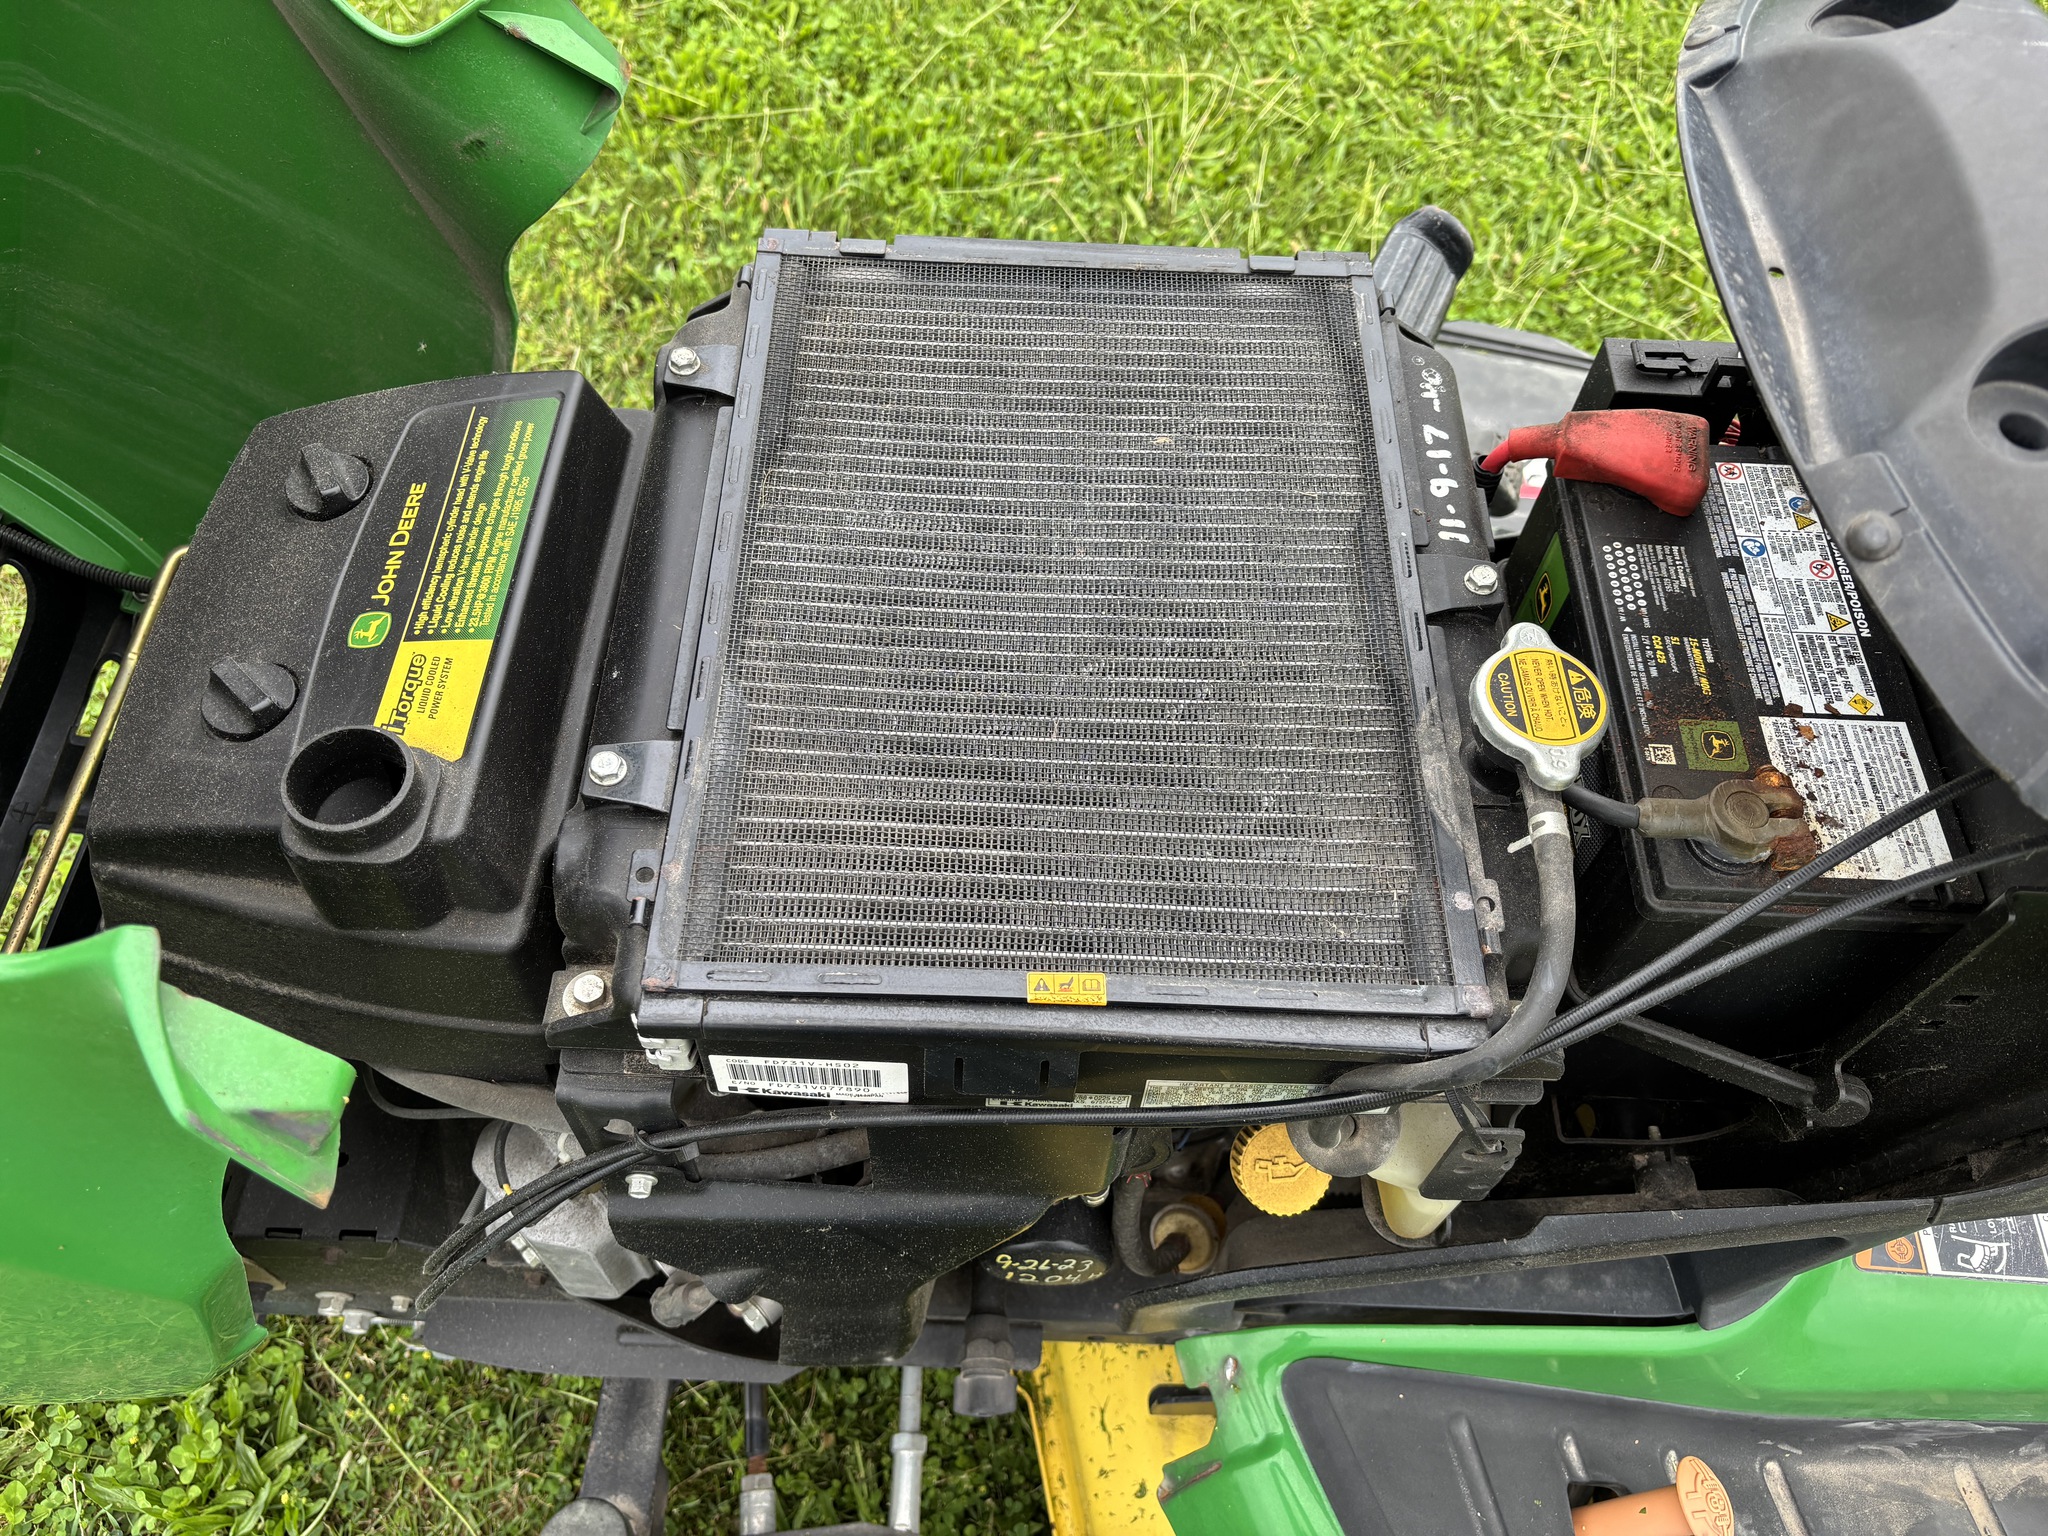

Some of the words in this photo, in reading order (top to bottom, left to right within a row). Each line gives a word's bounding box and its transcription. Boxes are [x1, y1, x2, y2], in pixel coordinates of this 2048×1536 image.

[468, 415, 489, 449] technology
[505, 419, 523, 452] conditions
[521, 421, 535, 441] power
[461, 449, 479, 473] V-Valve
[477, 449, 490, 459] life
[499, 452, 514, 471] tough
[515, 442, 530, 460] gross
[457, 473, 471, 487] with
[471, 460, 487, 482] engine
[508, 460, 525, 486] certified
[492, 471, 509, 496] through
[515, 476, 530, 496] 675cc
[451, 488, 467, 504] head
[463, 483, 481, 509] extends
[443, 505, 462, 531] cylinder
[459, 510, 473, 523] and
[471, 502, 487, 525] design
[484, 497, 501, 524] charges
[496, 487, 517, 530] manufacturer
[453, 524, 468, 543] noise
[462, 526, 481, 553] cylinder
[504, 521, 517, 536] SAE
[371, 549, 404, 606] JOHN
[389, 481, 427, 546] DEERE
[431, 532, 454, 573] hemispheric
[474, 525, 493, 559] response
[489, 531, 505, 554] engine
[500, 538, 513, 551] with
[444, 544, 463, 571] reduces
[456, 554, 472, 575] V-twin
[483, 556, 498, 573] RPM
[466, 561, 483, 587] throttle
[488, 552, 509, 593] accordance
[419, 574, 441, 610] efficiency
[435, 573, 454, 602] Cooling
[446, 577, 466, 610] vibration
[414, 611, 430, 629] High
[427, 603, 445, 628] Liquid
[441, 611, 456, 627] Low
[454, 589, 475, 627] Enhanced
[479, 603, 495, 626] Tested
[1651, 635, 1663, 649] CCA
[1518, 658, 1527, 667] NE
[1655, 650, 1666, 663] 425
[1688, 637, 1706, 672] 15-MONTH
[416, 687, 431, 713] LIQUID
[424, 655, 441, 685] COOLED
[427, 690, 444, 719] POWER
[436, 656, 454, 689] SYSTEM
[1522, 666, 1532, 686] JAMAIS
[1497, 672, 1517, 718] CAUTION
[1527, 686, 1536, 705] OUVRIR
[1531, 658, 1542, 677] NEVER
[1537, 677, 1545, 692] OPEN
[1541, 693, 1549, 708] WHEN
[1545, 708, 1554, 721] HOT.
[1571, 686, 1596, 720] 危険
[764, 1060, 860, 1068] FD731V-HS02
[761, 1088, 831, 1098] Kawasaki
